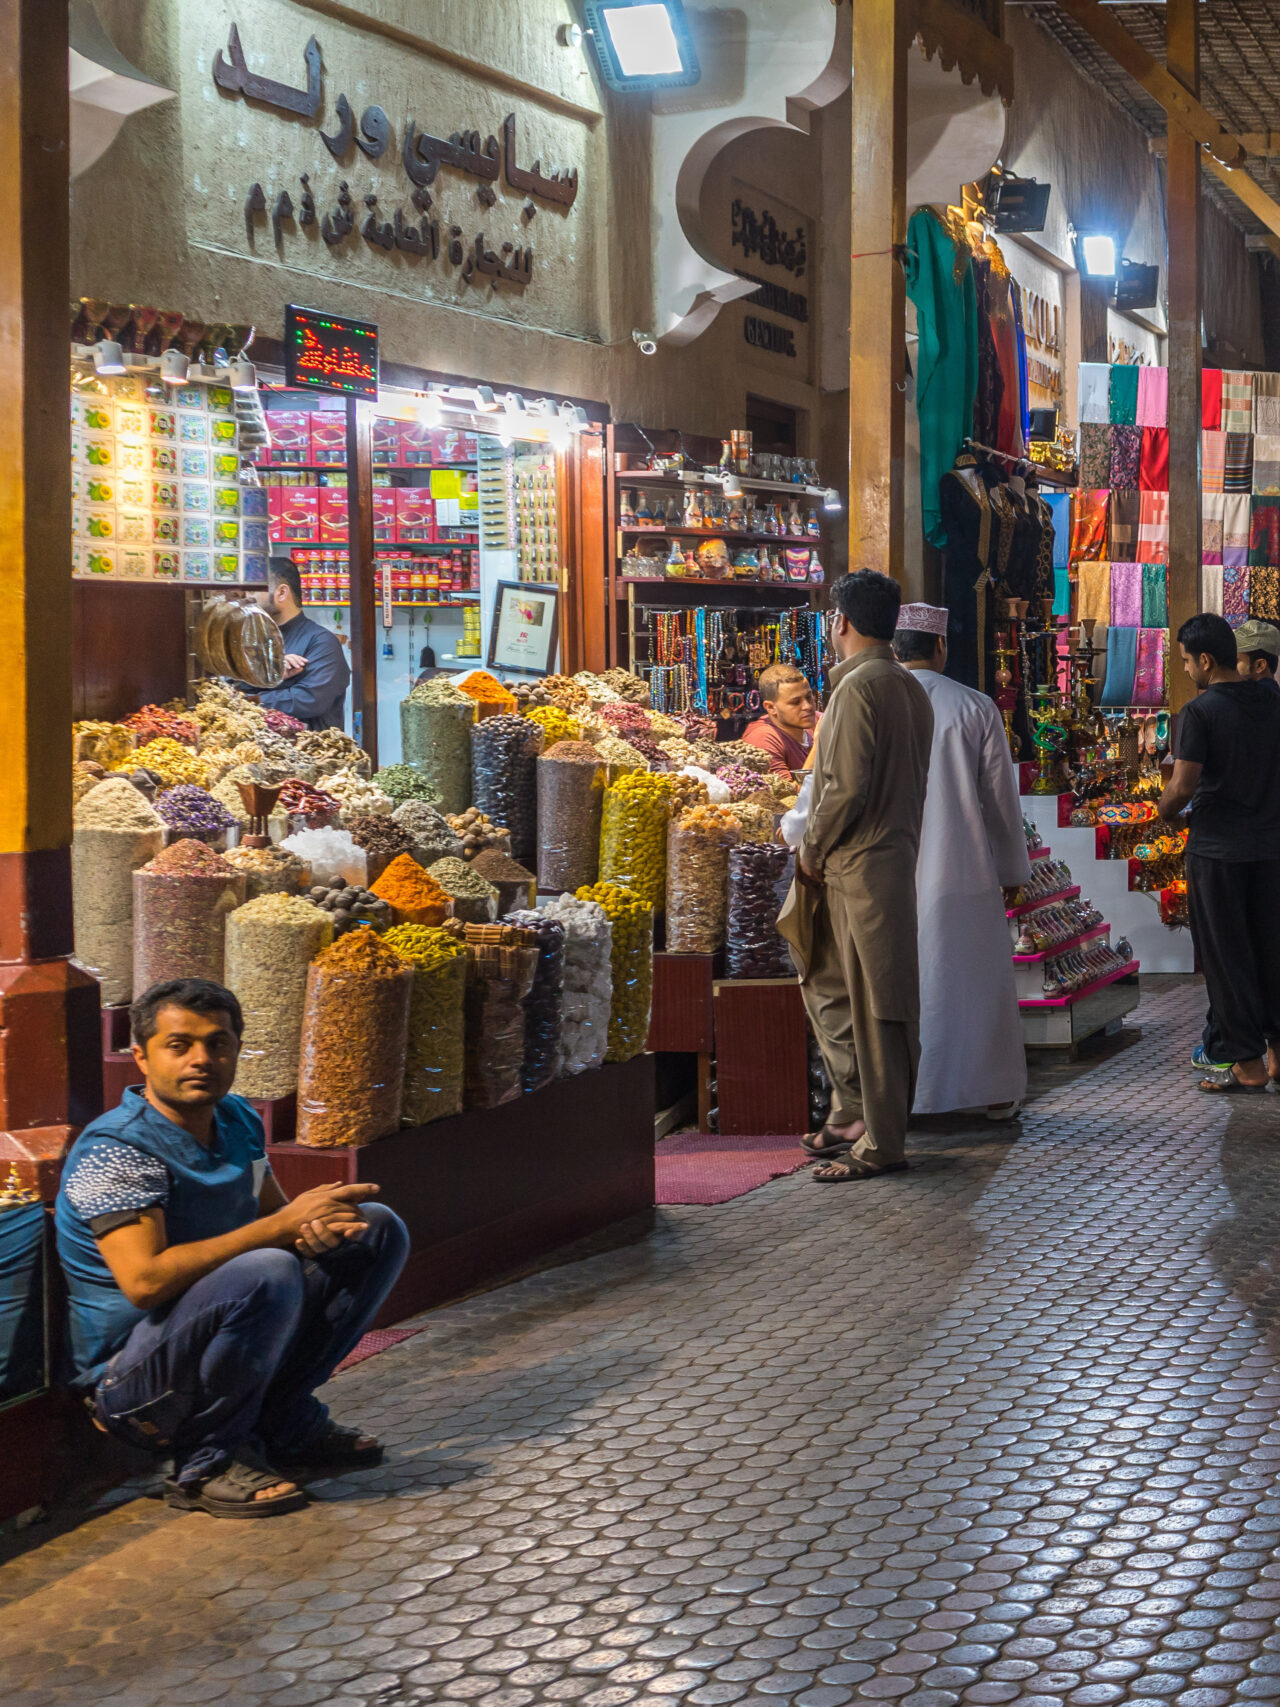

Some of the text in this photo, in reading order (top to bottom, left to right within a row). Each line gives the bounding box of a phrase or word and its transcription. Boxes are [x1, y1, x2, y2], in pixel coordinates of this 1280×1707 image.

[212, 21, 579, 220] سبايسي ورلد
[244, 182, 267, 251] م
[272, 189, 294, 255] م
[361, 193, 441, 261] العامة
[449, 226, 534, 292] للتجارة
